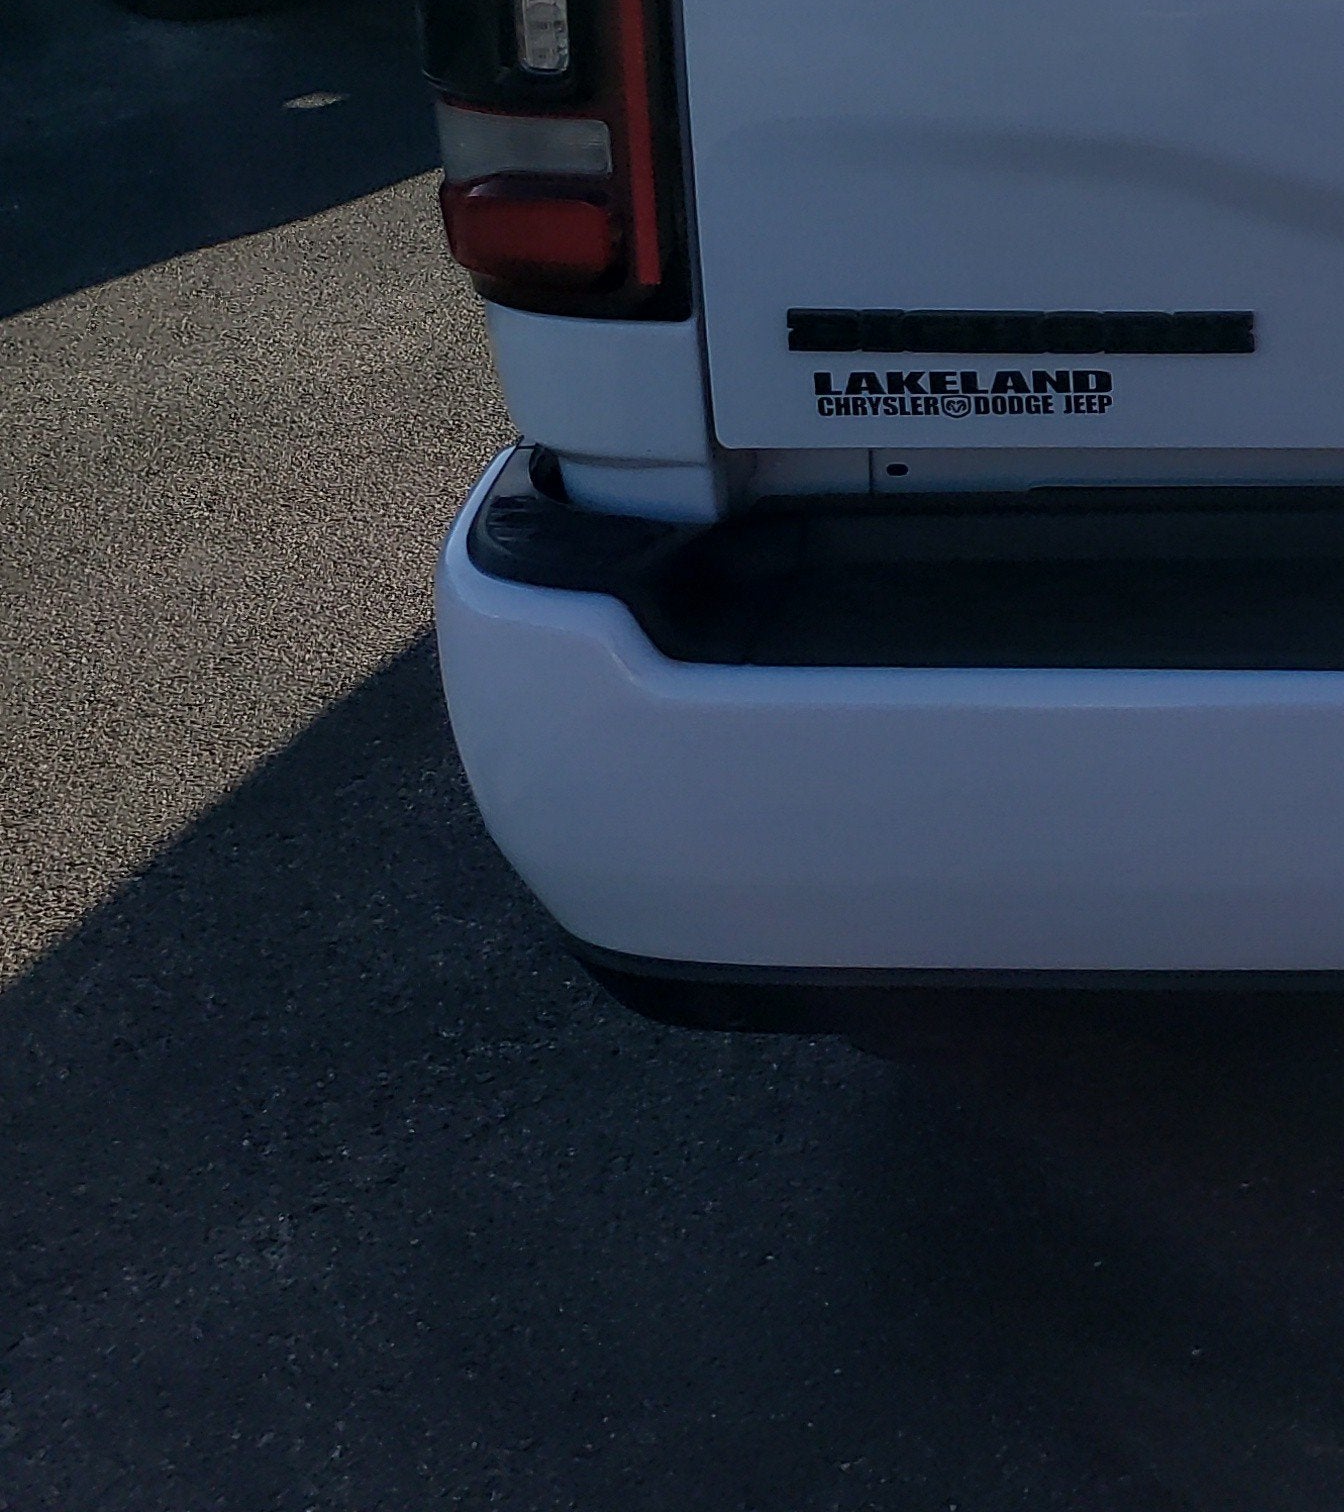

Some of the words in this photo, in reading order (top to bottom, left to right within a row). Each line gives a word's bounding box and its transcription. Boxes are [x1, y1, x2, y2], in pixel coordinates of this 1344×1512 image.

[813, 370, 1114, 394] LAKELAND
[817, 395, 939, 416] CHRYSLER
[974, 395, 1054, 414] DODGE
[1063, 395, 1112, 413] JEEP
